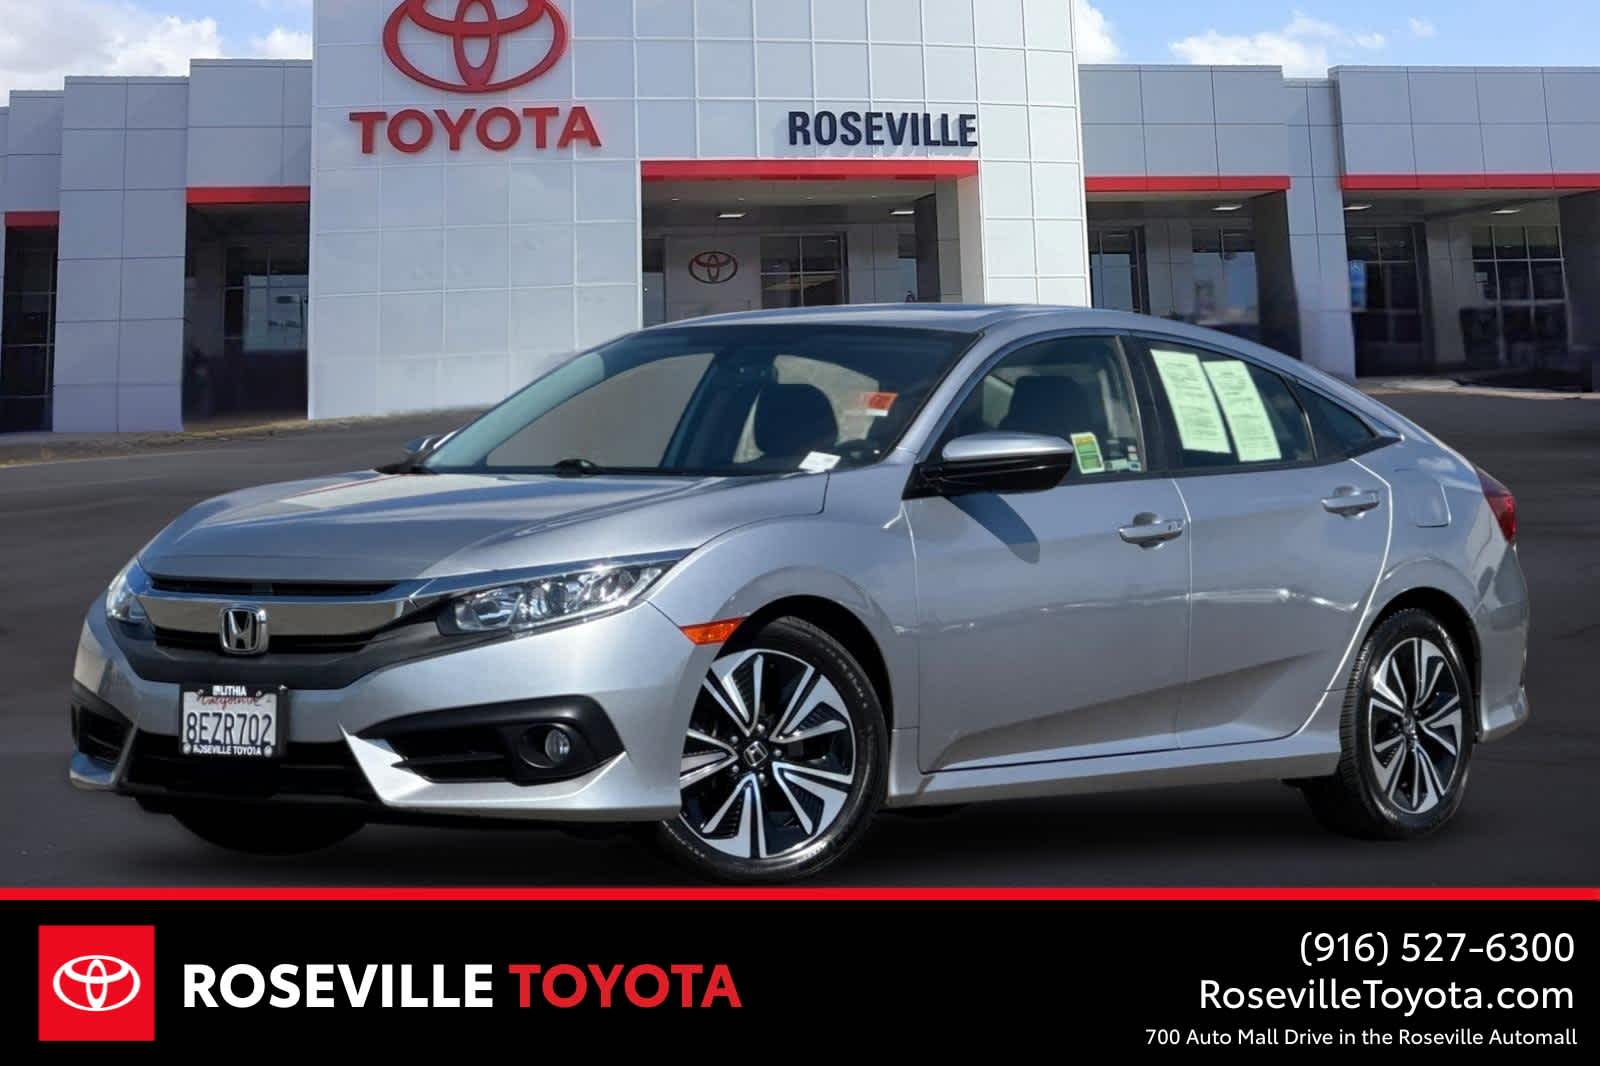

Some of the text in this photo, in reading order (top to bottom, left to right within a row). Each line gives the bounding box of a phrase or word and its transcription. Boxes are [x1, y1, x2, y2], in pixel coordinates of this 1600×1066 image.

[349, 106, 602, 154] TOYOTA
[788, 111, 978, 147] ROSEVILLE
[219, 685, 247, 696] LITHIA
[186, 712, 273, 747] 8EZR702
